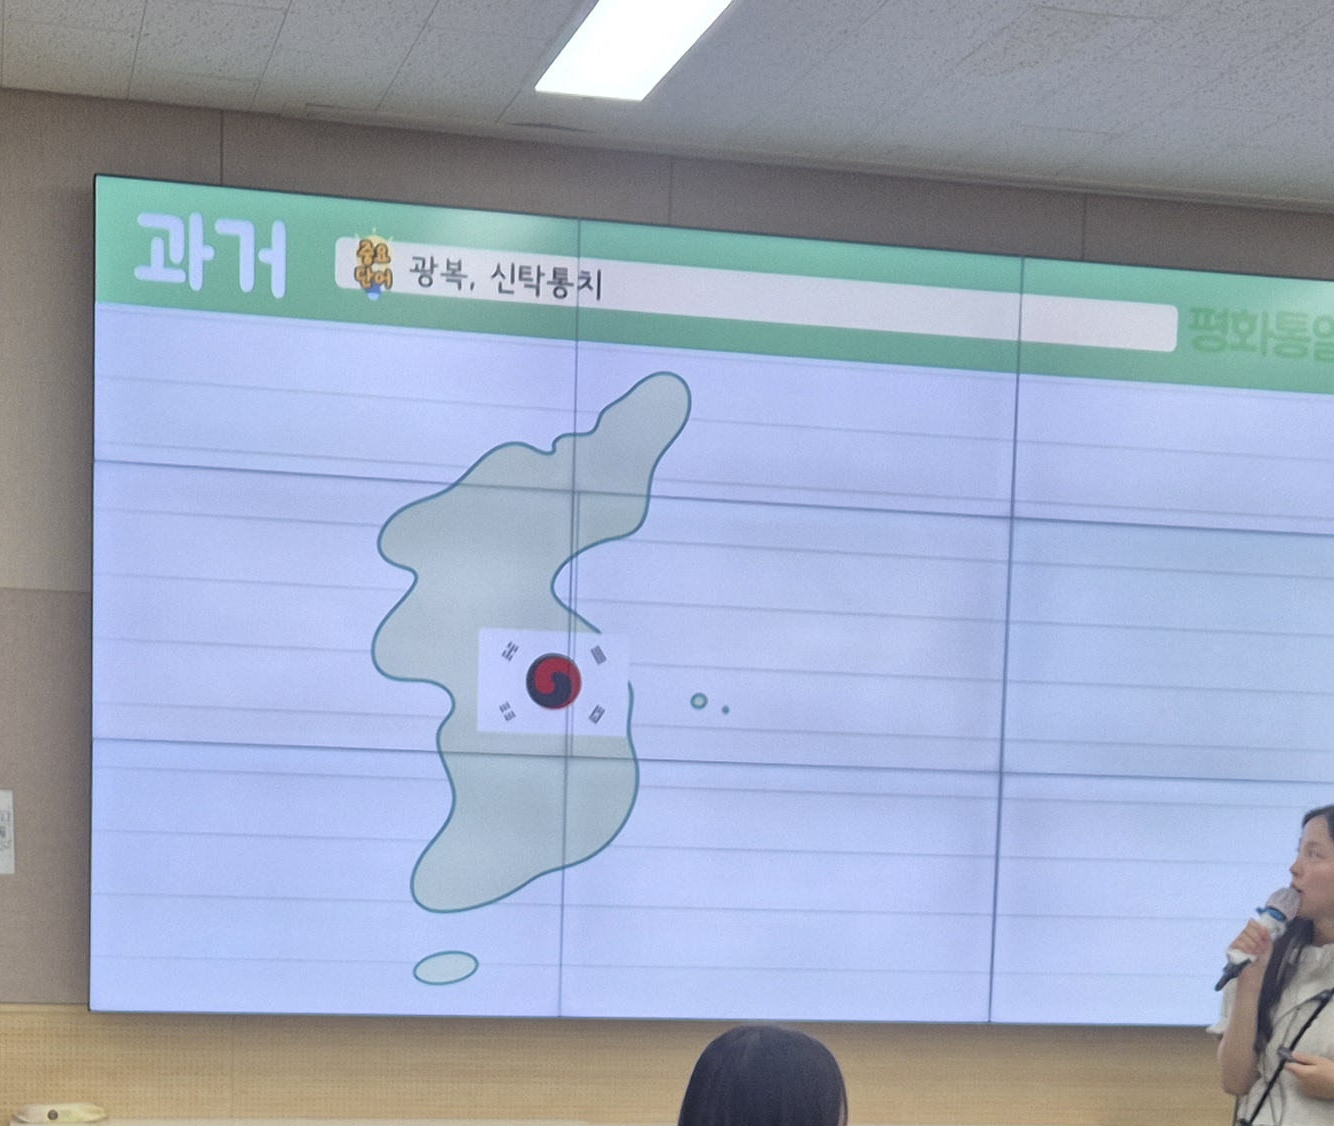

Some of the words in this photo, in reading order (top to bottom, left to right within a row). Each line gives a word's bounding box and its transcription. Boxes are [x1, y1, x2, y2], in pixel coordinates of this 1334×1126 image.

[134, 211, 287, 299] 과거
[356, 239, 392, 267] 중요
[354, 266, 394, 290] 단어
[409, 255, 476, 292] 광복,
[490, 261, 603, 302] 신탁통치
